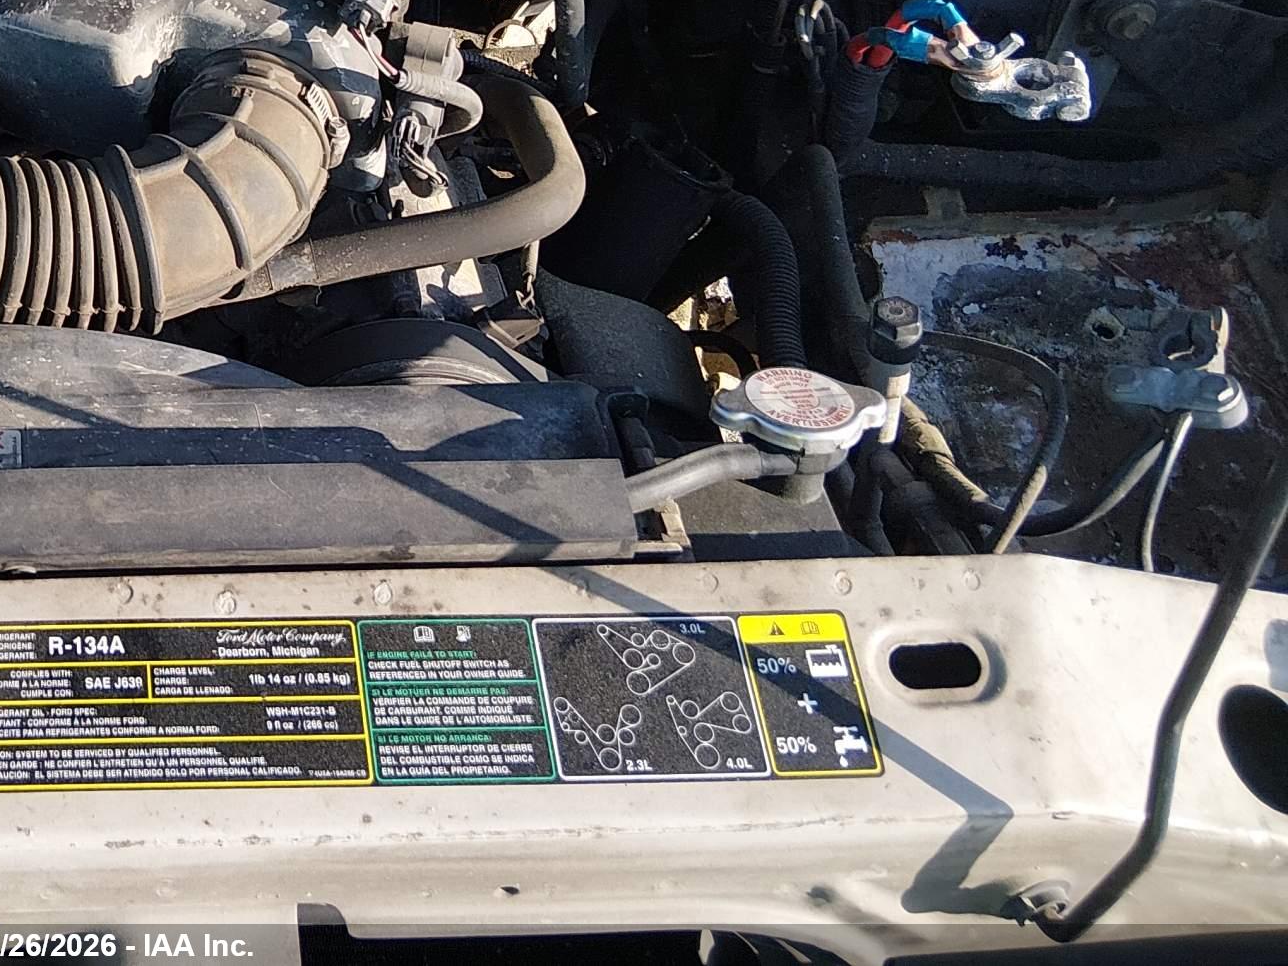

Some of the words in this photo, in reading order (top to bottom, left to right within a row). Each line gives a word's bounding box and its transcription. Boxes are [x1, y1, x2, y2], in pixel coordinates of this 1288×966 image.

[755, 369, 813, 381] WARNING
[680, 623, 705, 634] 3.0L
[49, 636, 125, 655] R-134A
[219, 647, 268, 658] Dearborn,
[272, 646, 319, 658] Michigan
[757, 656, 797, 673] 50%
[85, 677, 110, 688] SAE
[268, 674, 280, 683] 14
[304, 673, 330, 685] (0.85
[332, 673, 351, 685] kg)
[777, 737, 817, 753] 50%
[626, 759, 652, 771] 2.3L
[727, 757, 752, 769] 4.0L
